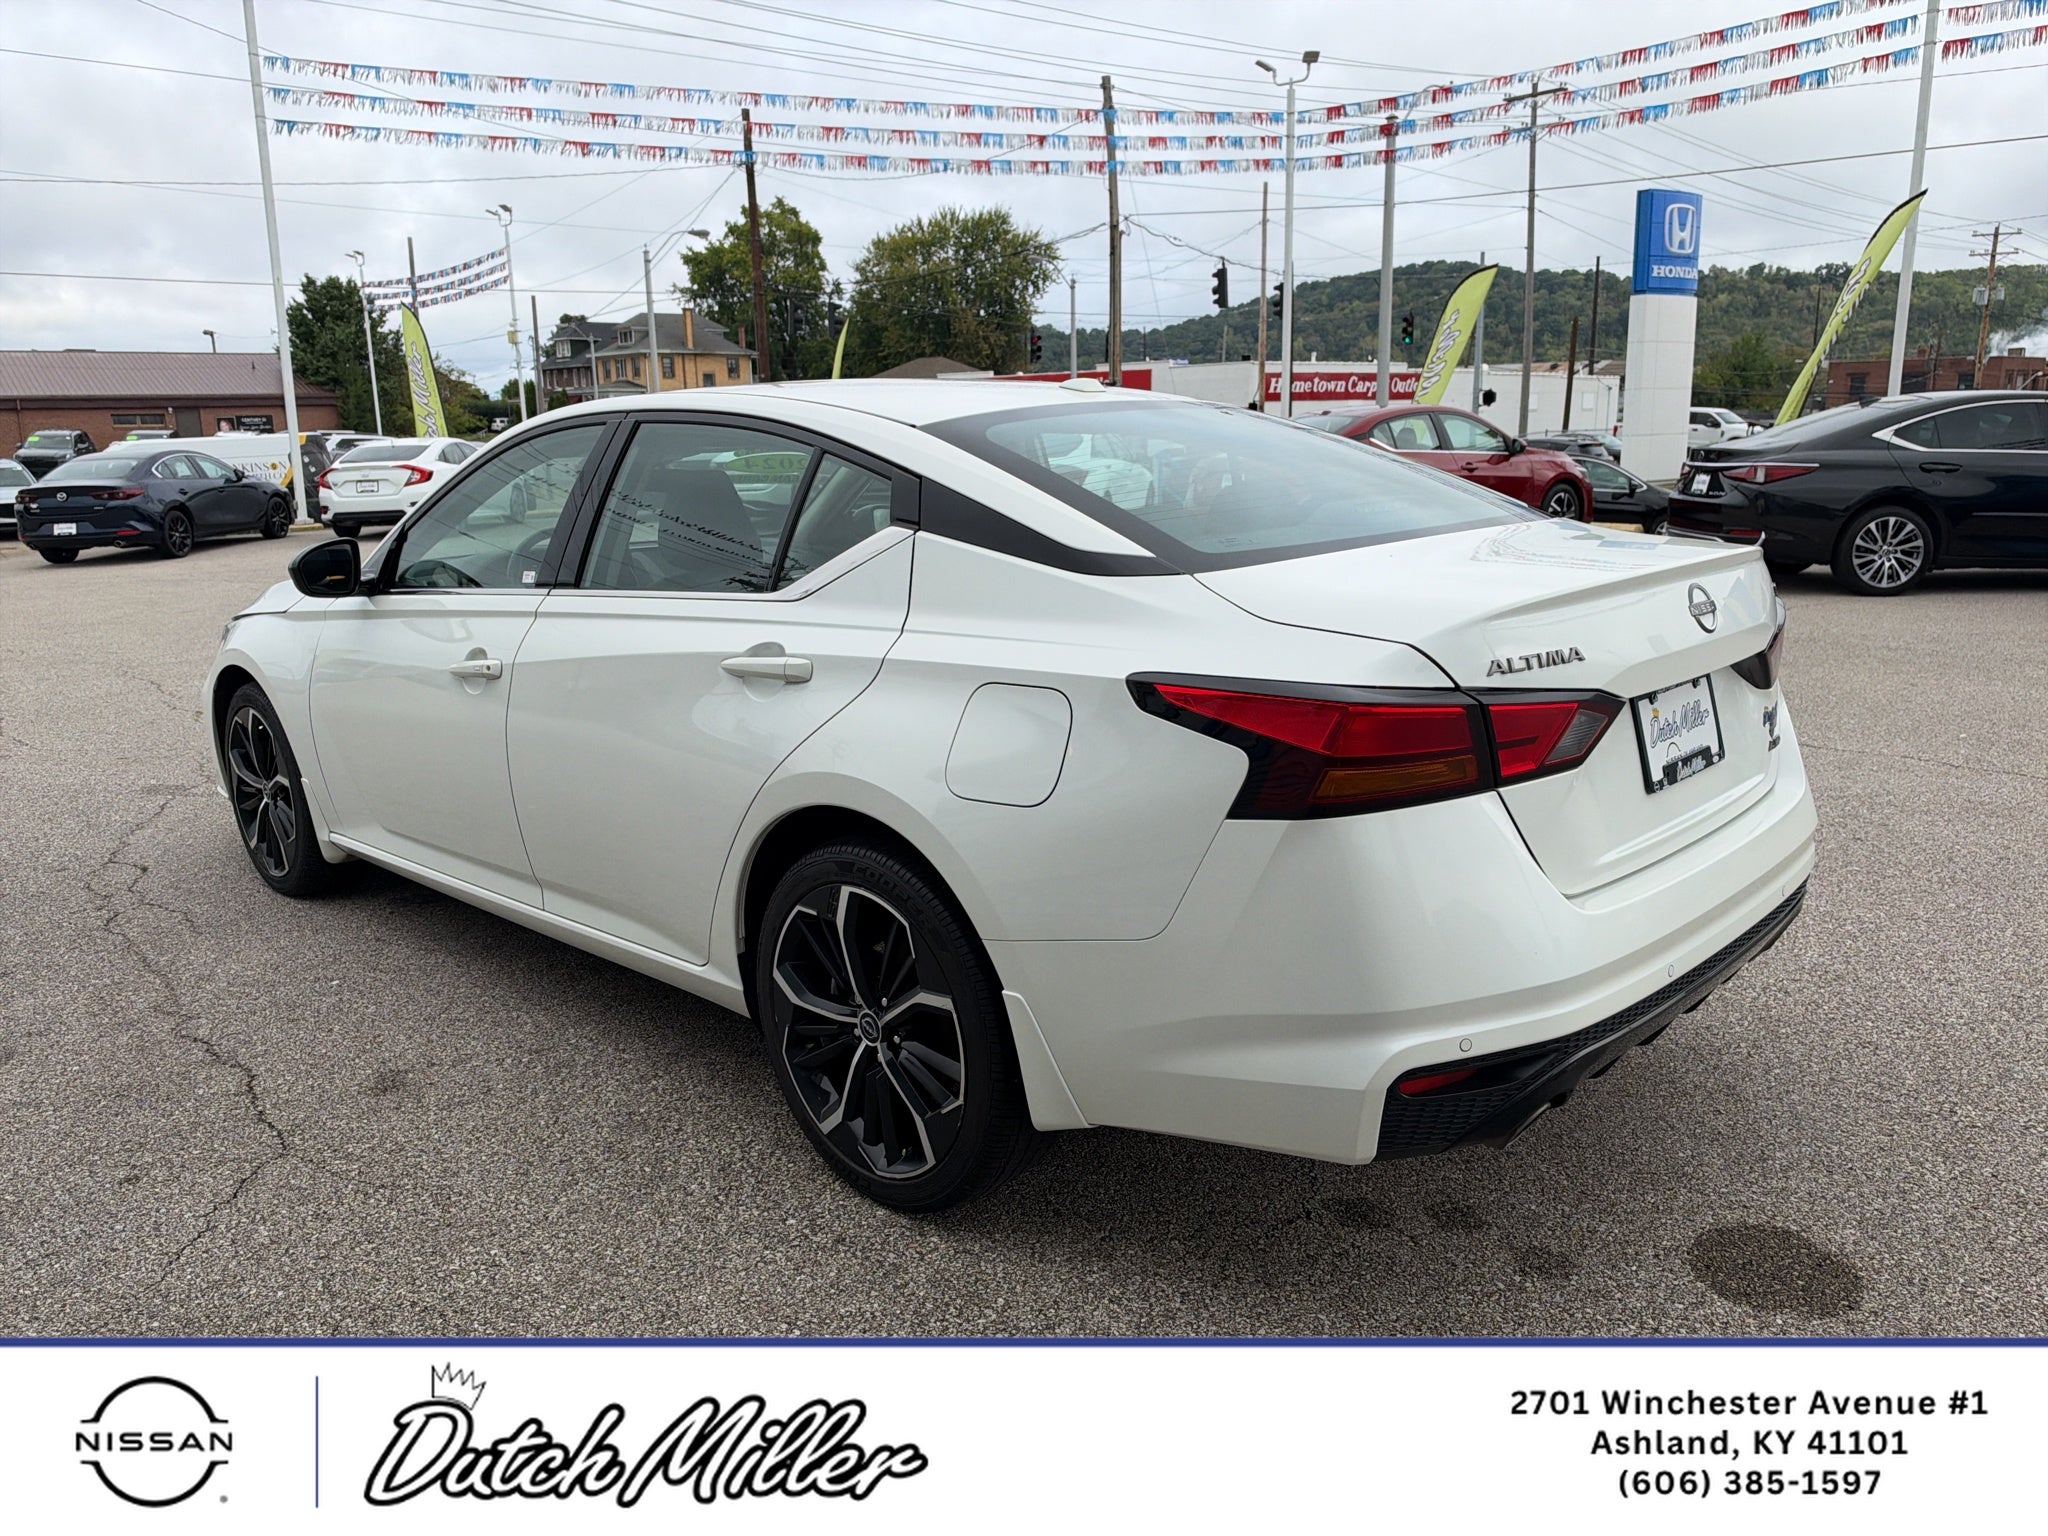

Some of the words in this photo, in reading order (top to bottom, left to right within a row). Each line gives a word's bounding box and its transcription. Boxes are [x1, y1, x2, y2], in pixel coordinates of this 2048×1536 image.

[1652, 265, 1698, 279] HONDA
[407, 341, 436, 414] Miller
[1268, 375, 1345, 394] Hmetown
[1348, 376, 1390, 397] Carp
[1486, 646, 1586, 677] ALTIMA
[1650, 709, 1680, 749] Dutch
[1678, 699, 1710, 738] Miller
